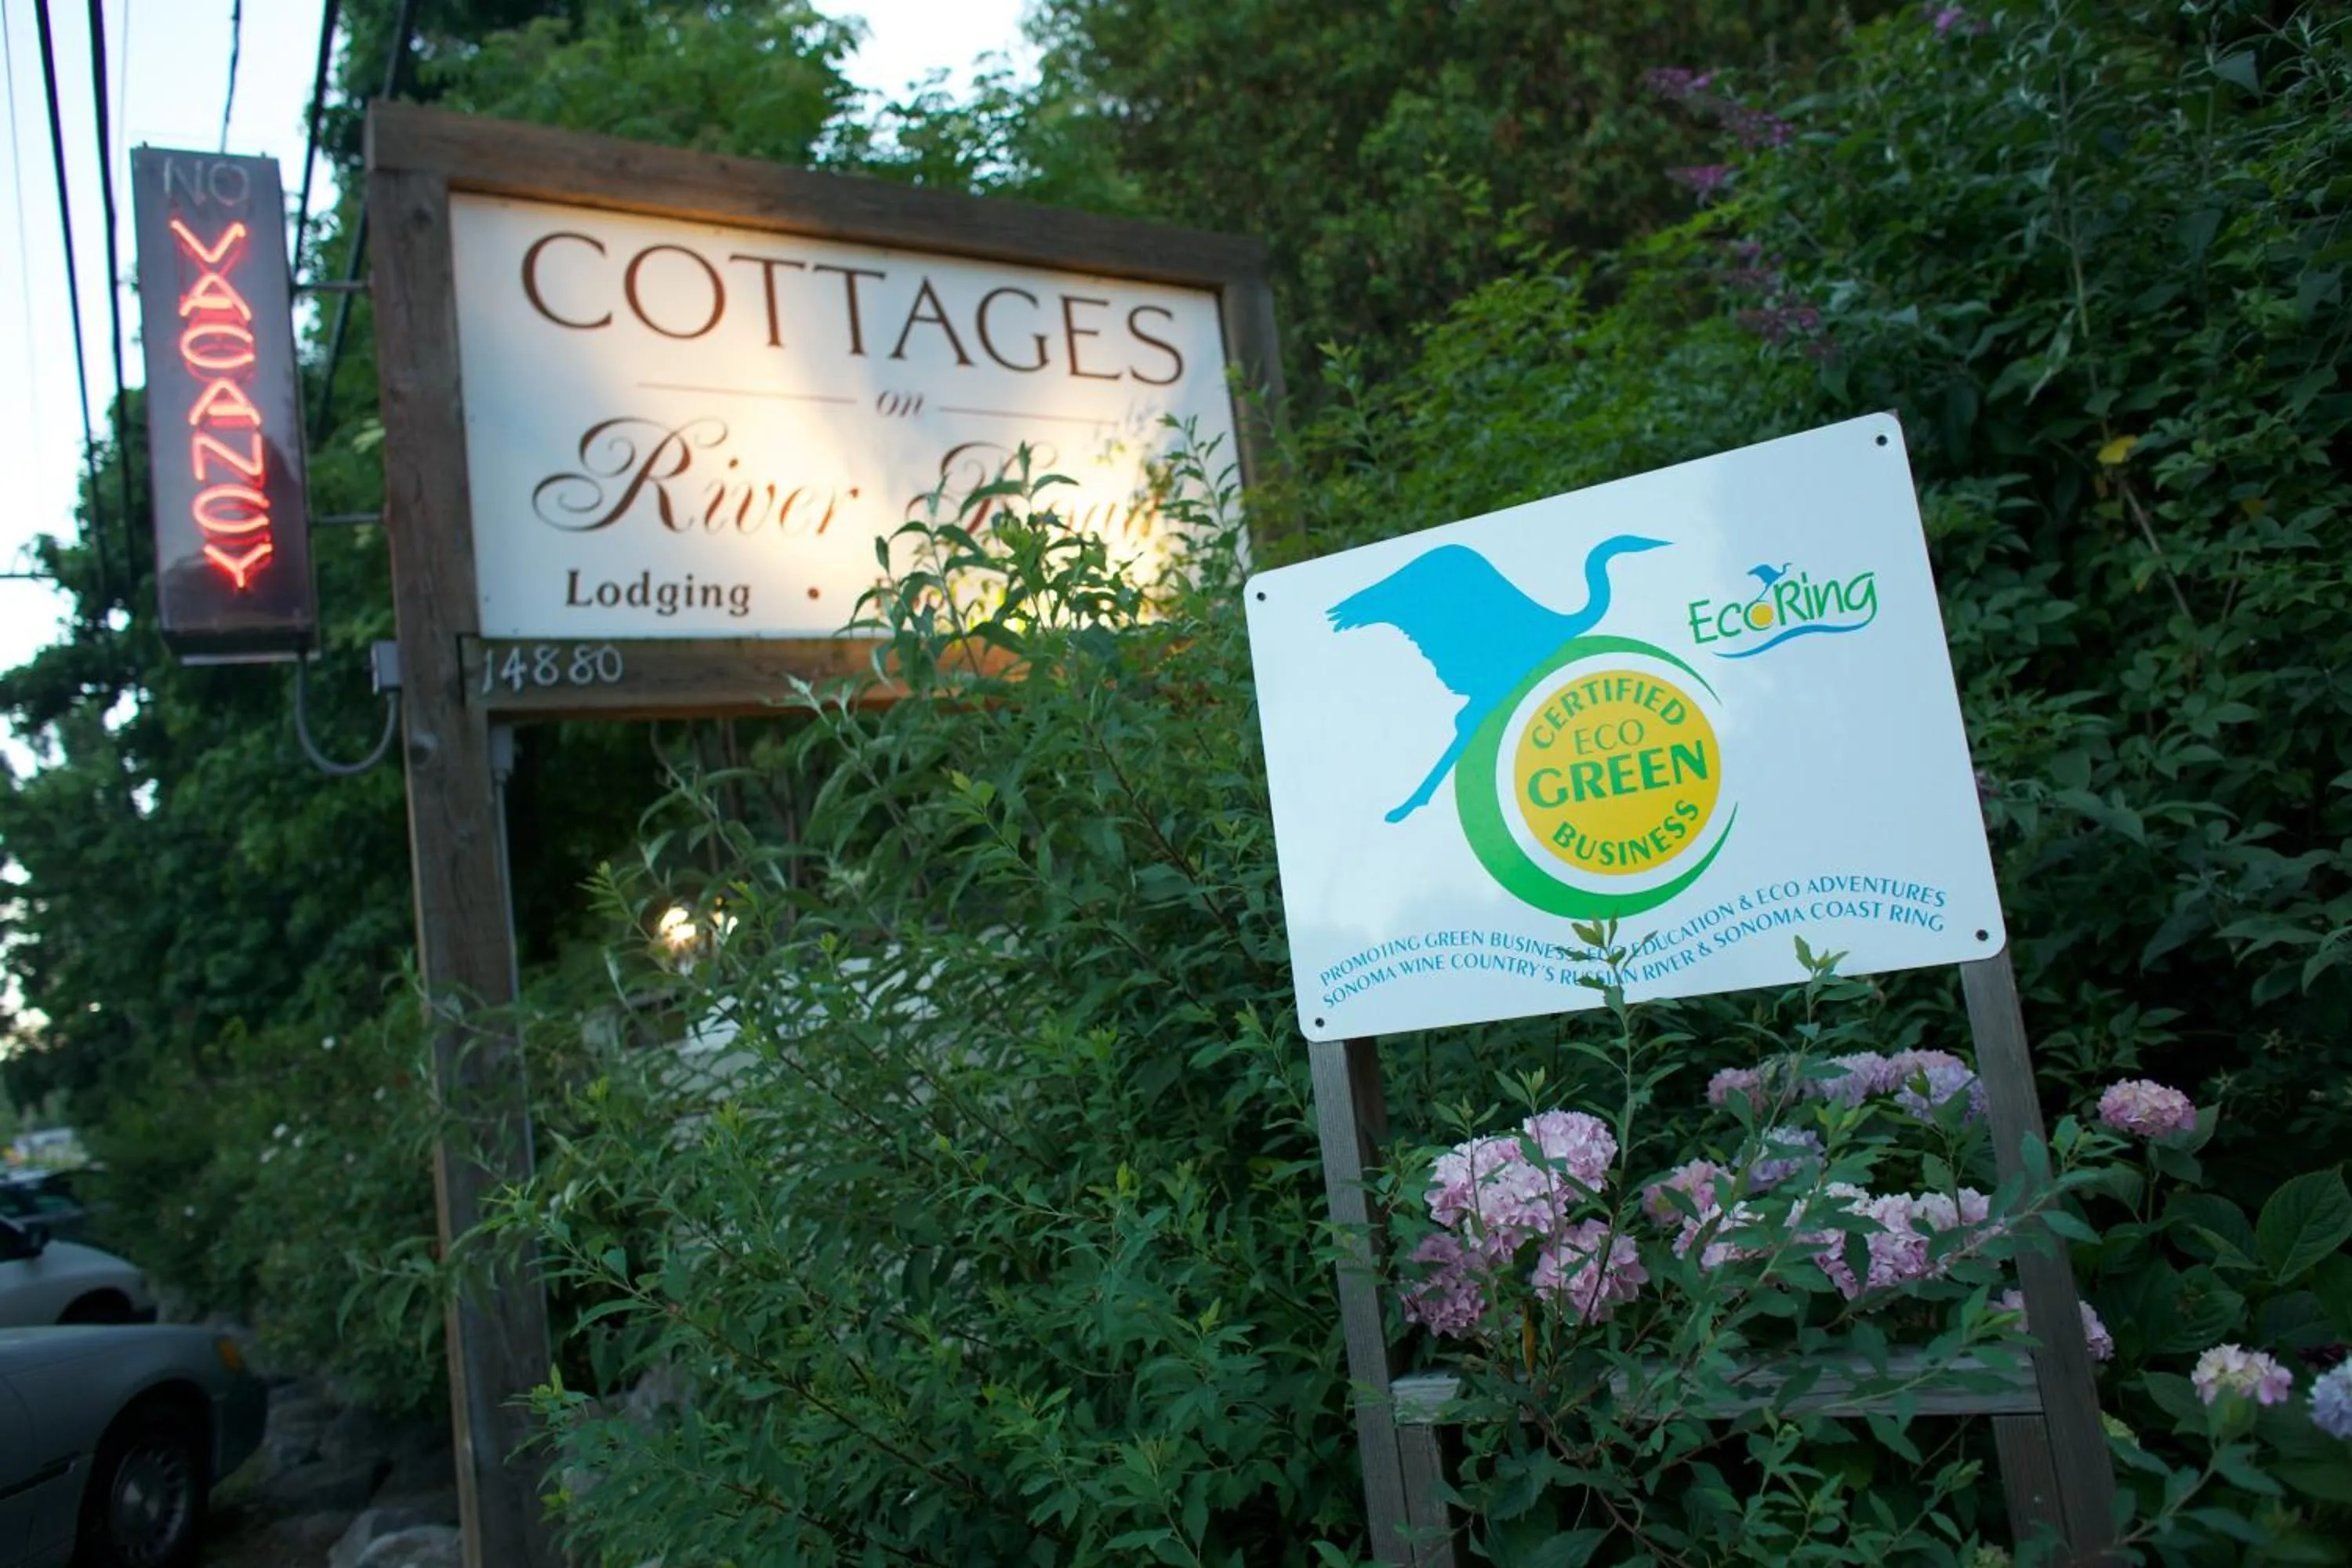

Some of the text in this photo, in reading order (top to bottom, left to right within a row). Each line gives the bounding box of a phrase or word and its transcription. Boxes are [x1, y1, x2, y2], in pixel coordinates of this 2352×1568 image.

[163, 157, 251, 206] NO
[521, 231, 1184, 387] COTTAGES
[169, 220, 273, 588] VACANCY
[876, 389, 926, 418] on
[532, 416, 860, 535] River
[565, 568, 752, 617] Lodging
[481, 644, 623, 695] 14880
[1531, 677, 1686, 750] CERTIFIED
[1574, 718, 1645, 756] ECO
[1527, 739, 1709, 809] GREEN
[1552, 800, 1699, 866] BUSINESS
[1319, 935, 1420, 987] PROMOTING
[1425, 930, 1485, 948] GREEN
[1739, 895, 1754, 910] &
[1755, 880, 1801, 905] ECO
[1806, 875, 1947, 908] ADVENTURES
[1323, 965, 1397, 1009] SONOMA
[1399, 954, 1445, 975] WINE
[1450, 952, 1555, 982] COUNTRY'S
[1642, 949, 1696, 981] RIVER
[1697, 942, 1713, 957] &
[1713, 906, 1806, 949] SONOMA
[1810, 901, 1886, 920] COAST
[1889, 903, 1945, 933] RING
